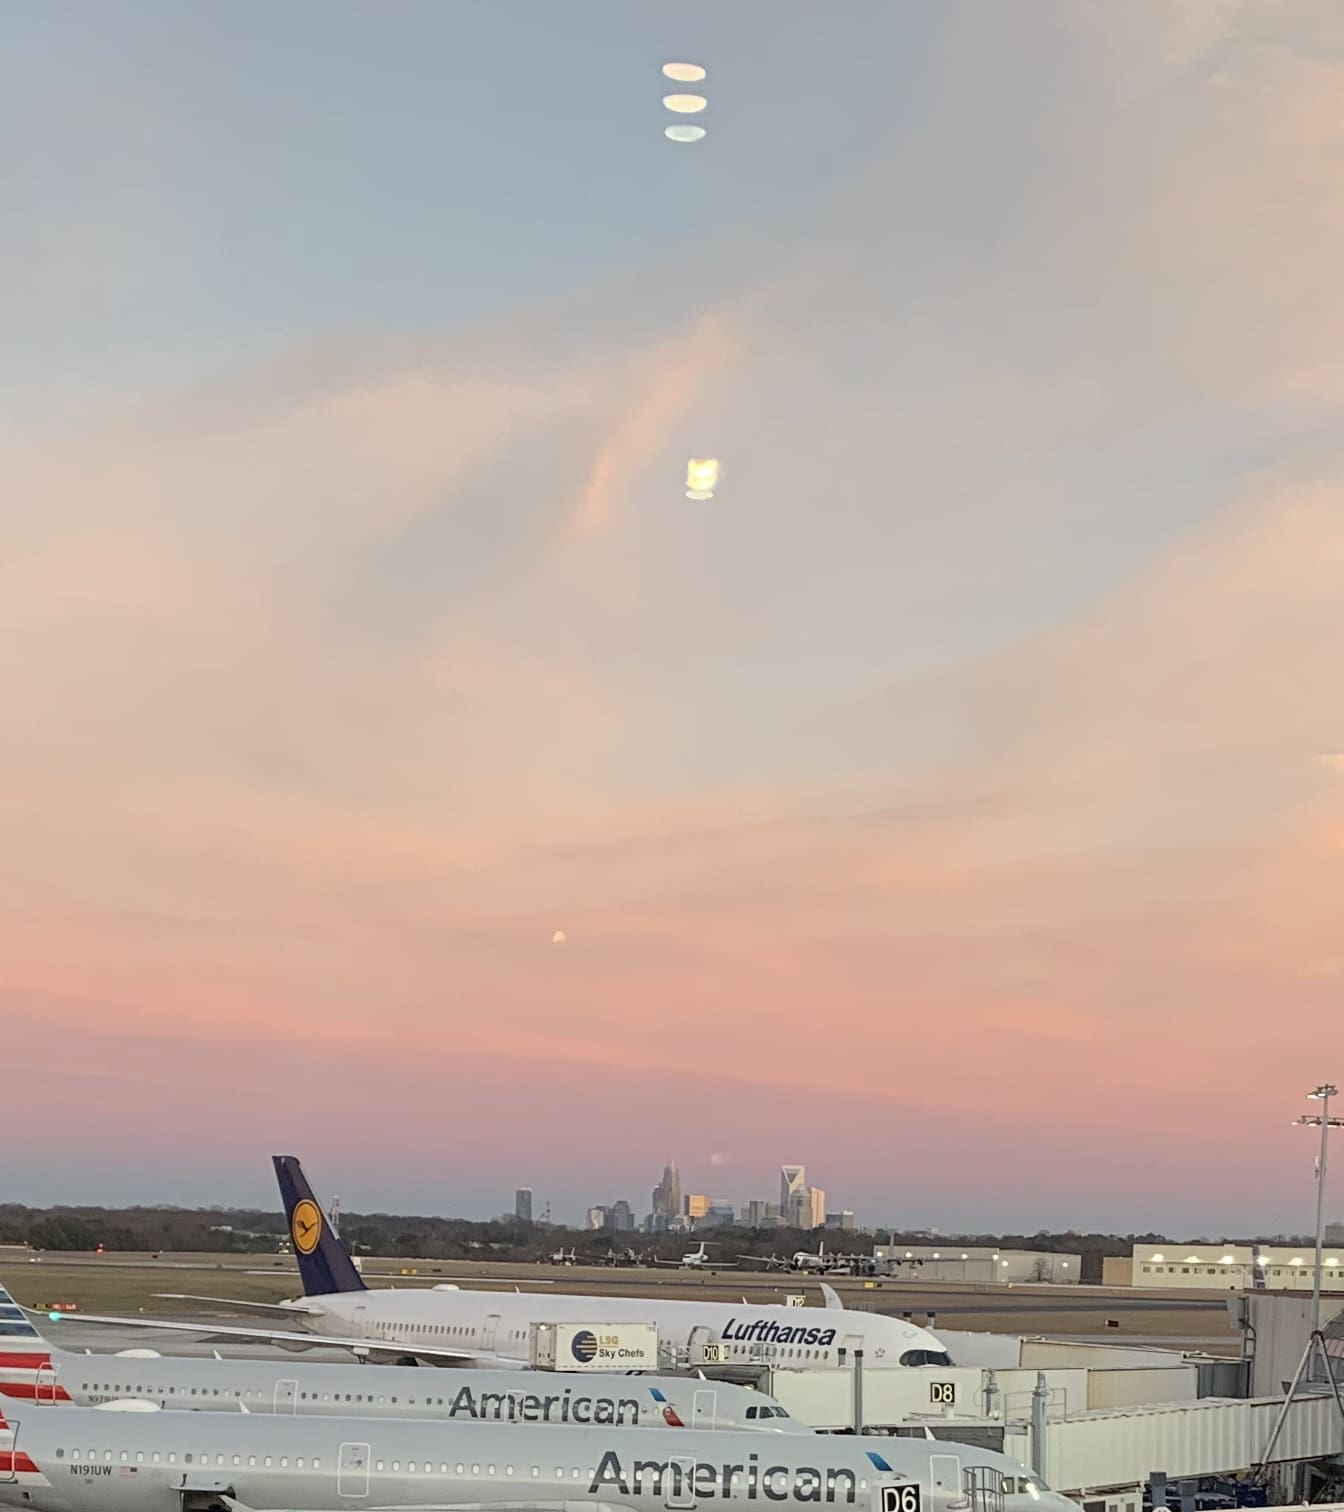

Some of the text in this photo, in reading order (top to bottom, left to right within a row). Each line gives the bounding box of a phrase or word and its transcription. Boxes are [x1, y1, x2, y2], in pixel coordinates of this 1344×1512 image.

[721, 1318, 837, 1346] Lufthansa
[599, 1348, 645, 1359] Sky Chefs
[704, 1345, 718, 1361] D10
[931, 1383, 953, 1402] D8
[449, 1386, 640, 1425] American
[70, 1464, 112, 1476] N191UW
[588, 1451, 856, 1504] American
